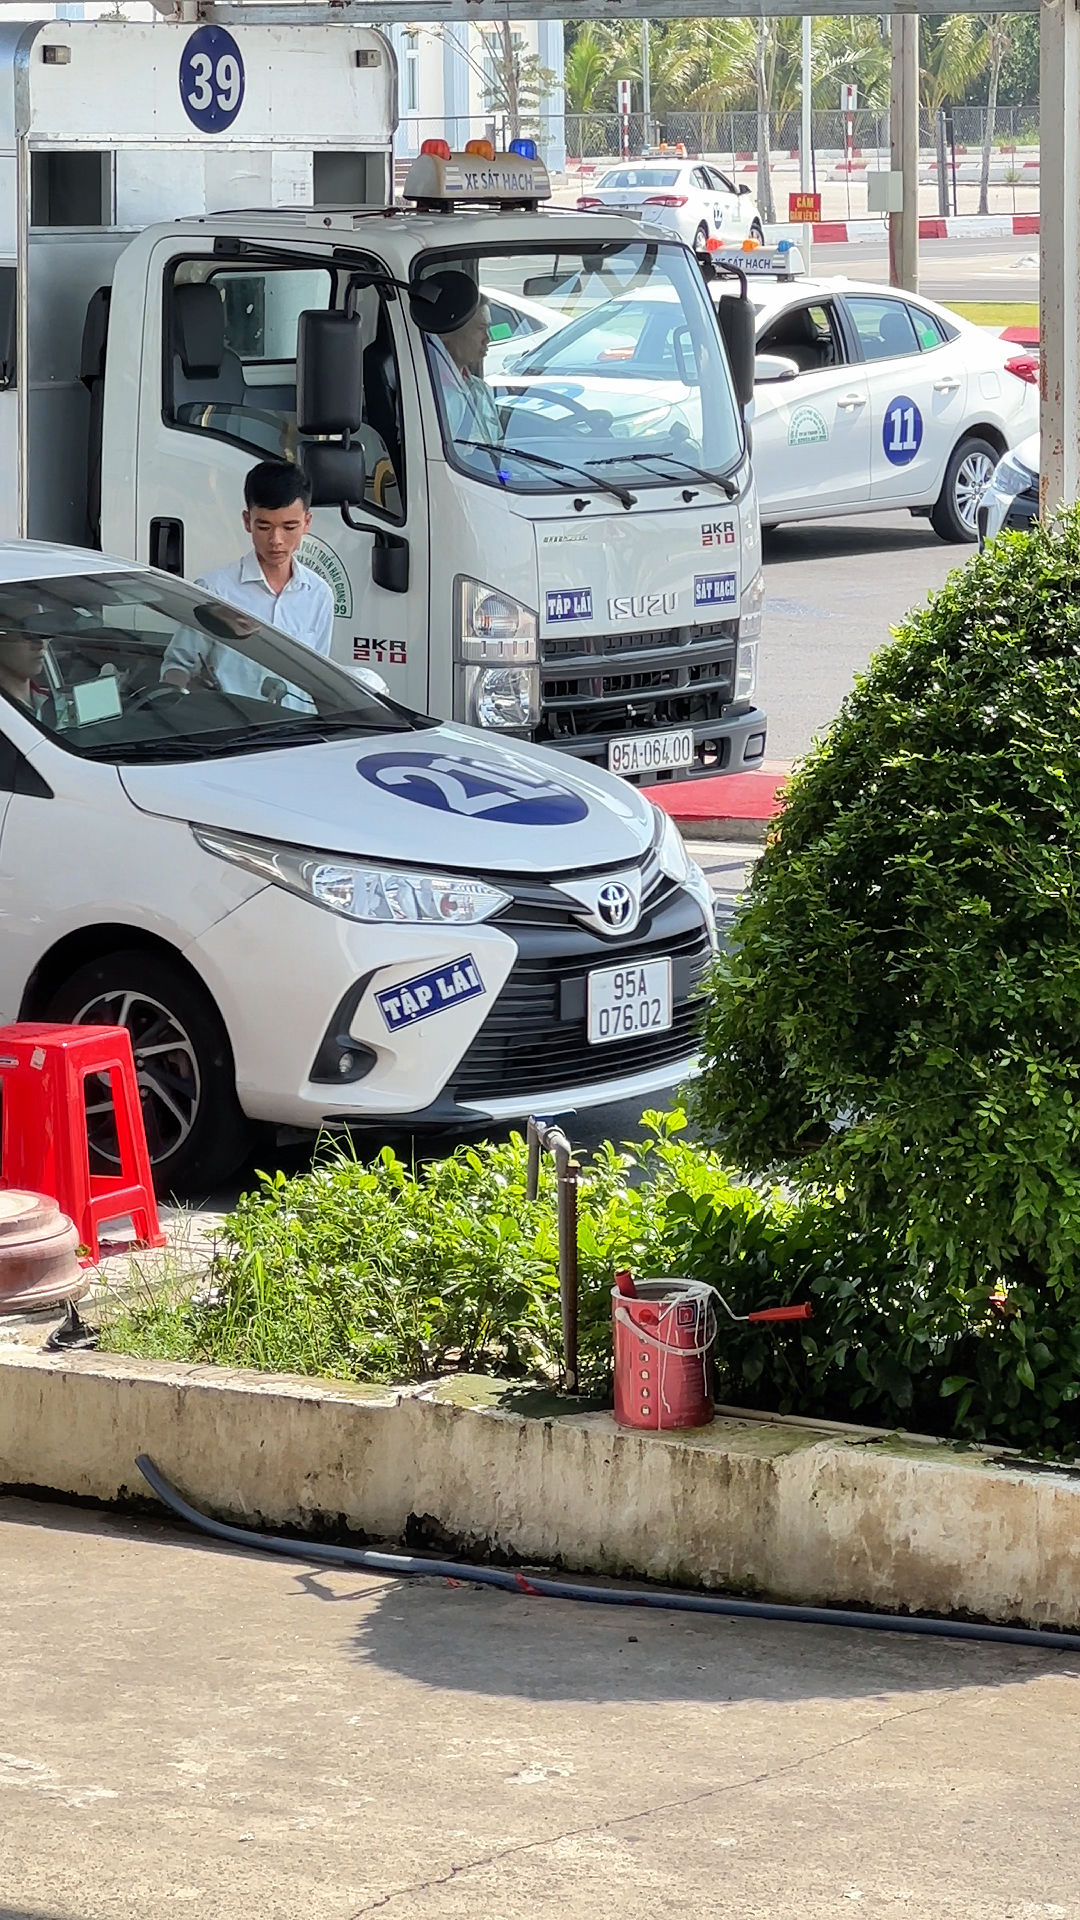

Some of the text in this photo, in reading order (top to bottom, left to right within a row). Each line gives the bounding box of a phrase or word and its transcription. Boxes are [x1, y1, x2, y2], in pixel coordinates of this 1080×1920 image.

[188, 53, 240, 111] 39
[465, 173, 479, 190] XE
[481, 169, 500, 190] SÁT
[745, 259, 771, 271] HẠCH
[889, 407, 917, 451] 11
[701, 522, 734, 535] QKR
[702, 533, 735, 546] 210
[696, 579, 735, 601] SÁT HẠCH
[548, 592, 592, 619] TẬP LÁI
[607, 592, 678, 620] ISUZU
[353, 637, 406, 652] QKR
[353, 649, 406, 664] 210
[613, 735, 690, 771] 95A-064.00
[376, 757, 563, 816] 21
[382, 965, 479, 1020] TẬP LÁI
[614, 968, 647, 1000] 95A
[599, 998, 661, 1036] 076.02
